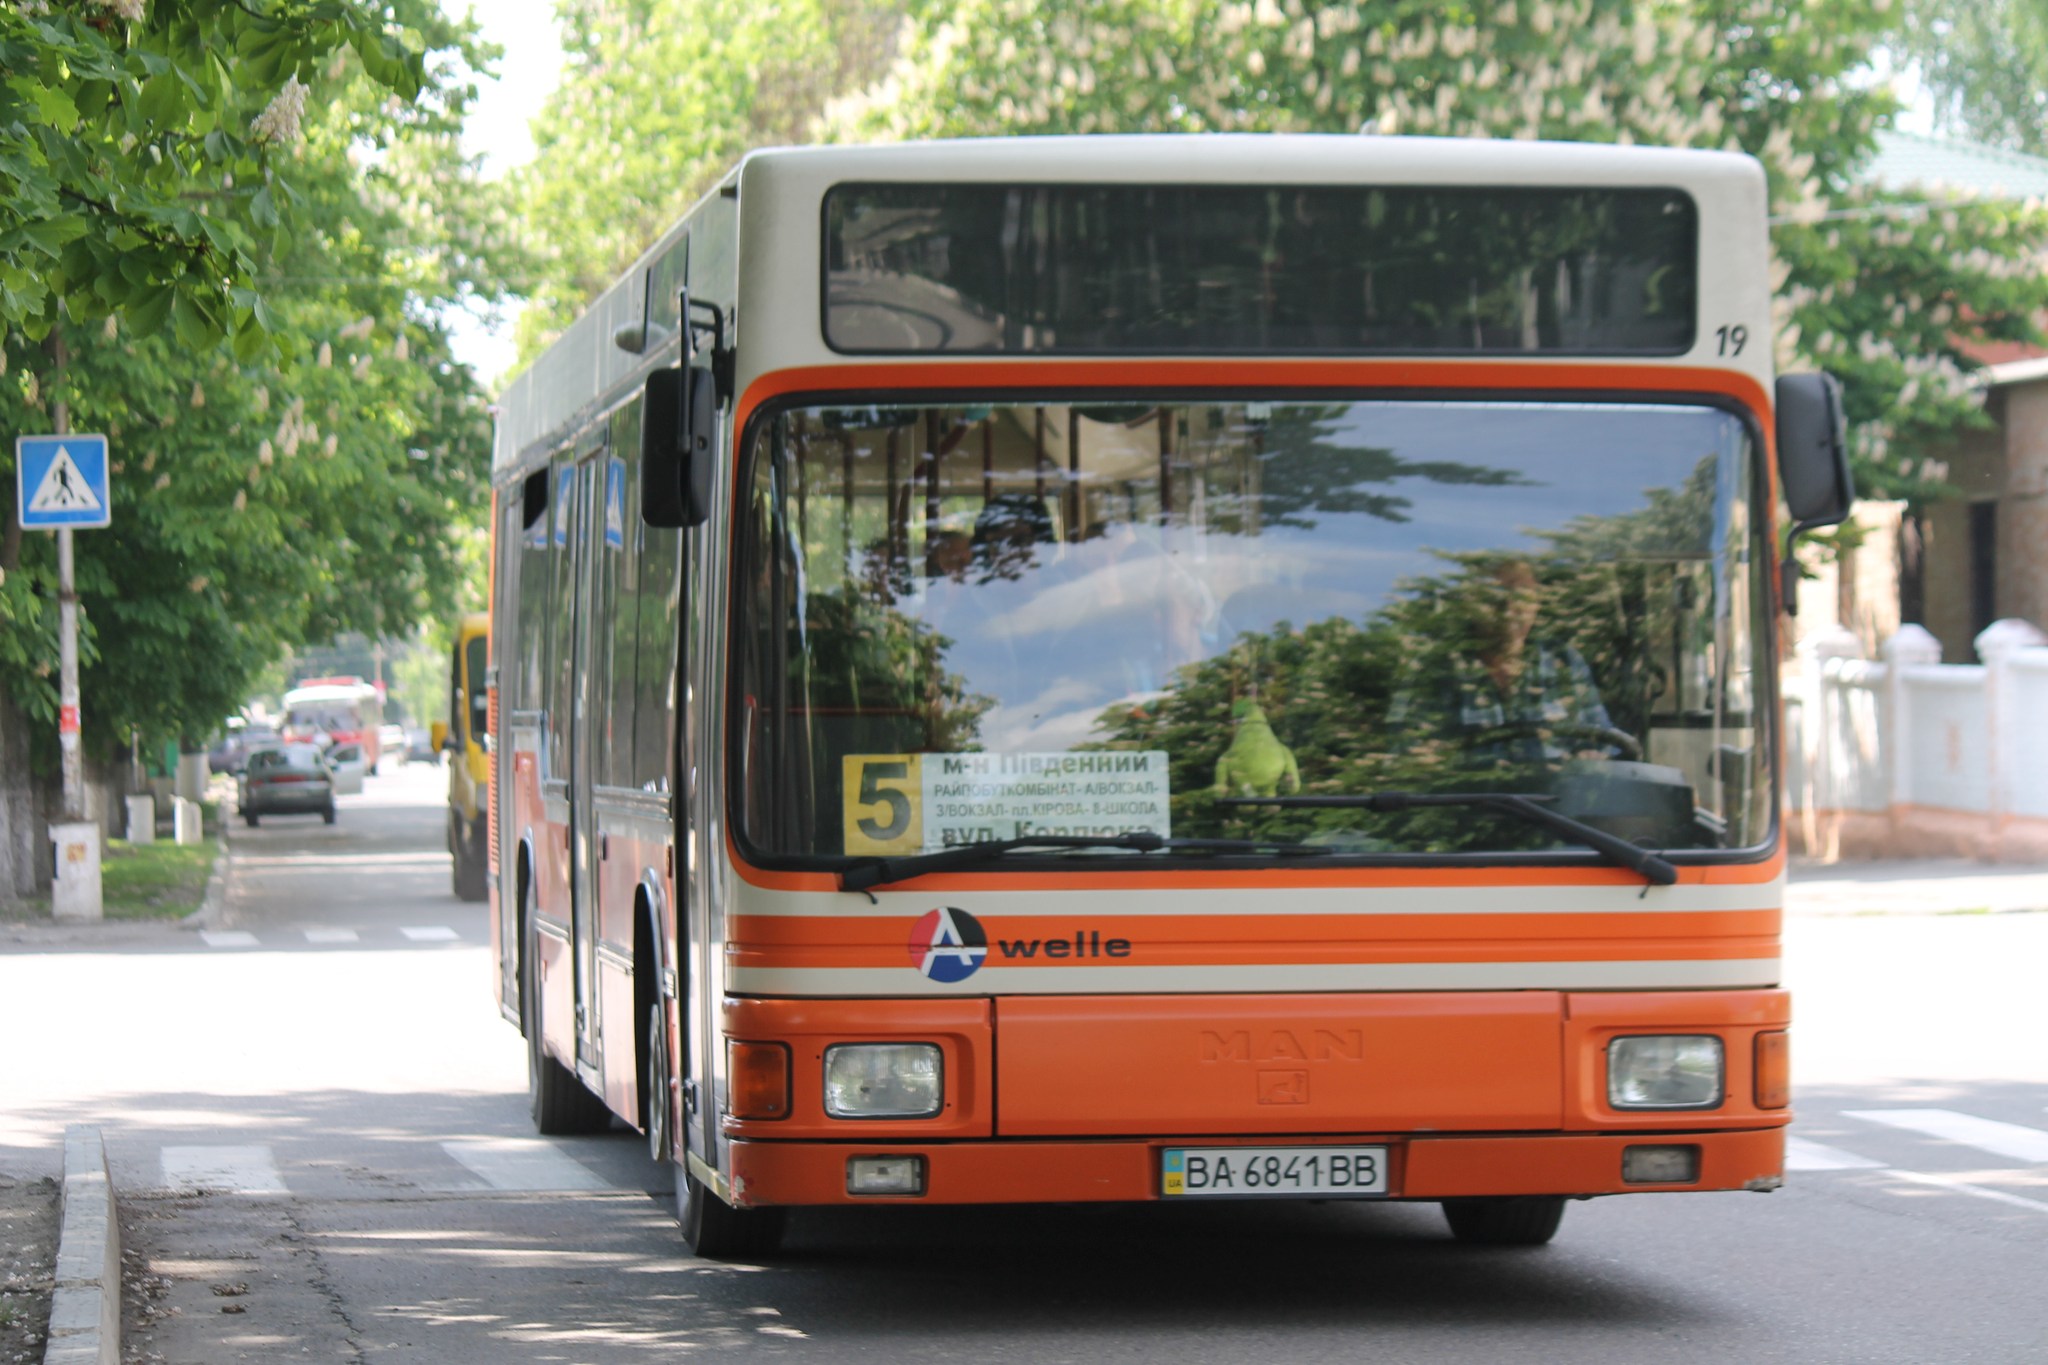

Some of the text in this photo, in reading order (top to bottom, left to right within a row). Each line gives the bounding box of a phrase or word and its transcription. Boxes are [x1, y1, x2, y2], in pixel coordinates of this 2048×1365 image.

[1715, 324, 1749, 358] 19
[857, 762, 911, 840] 5
[998, 931, 1131, 958] welle
[1200, 1029, 1364, 1062] MAN
